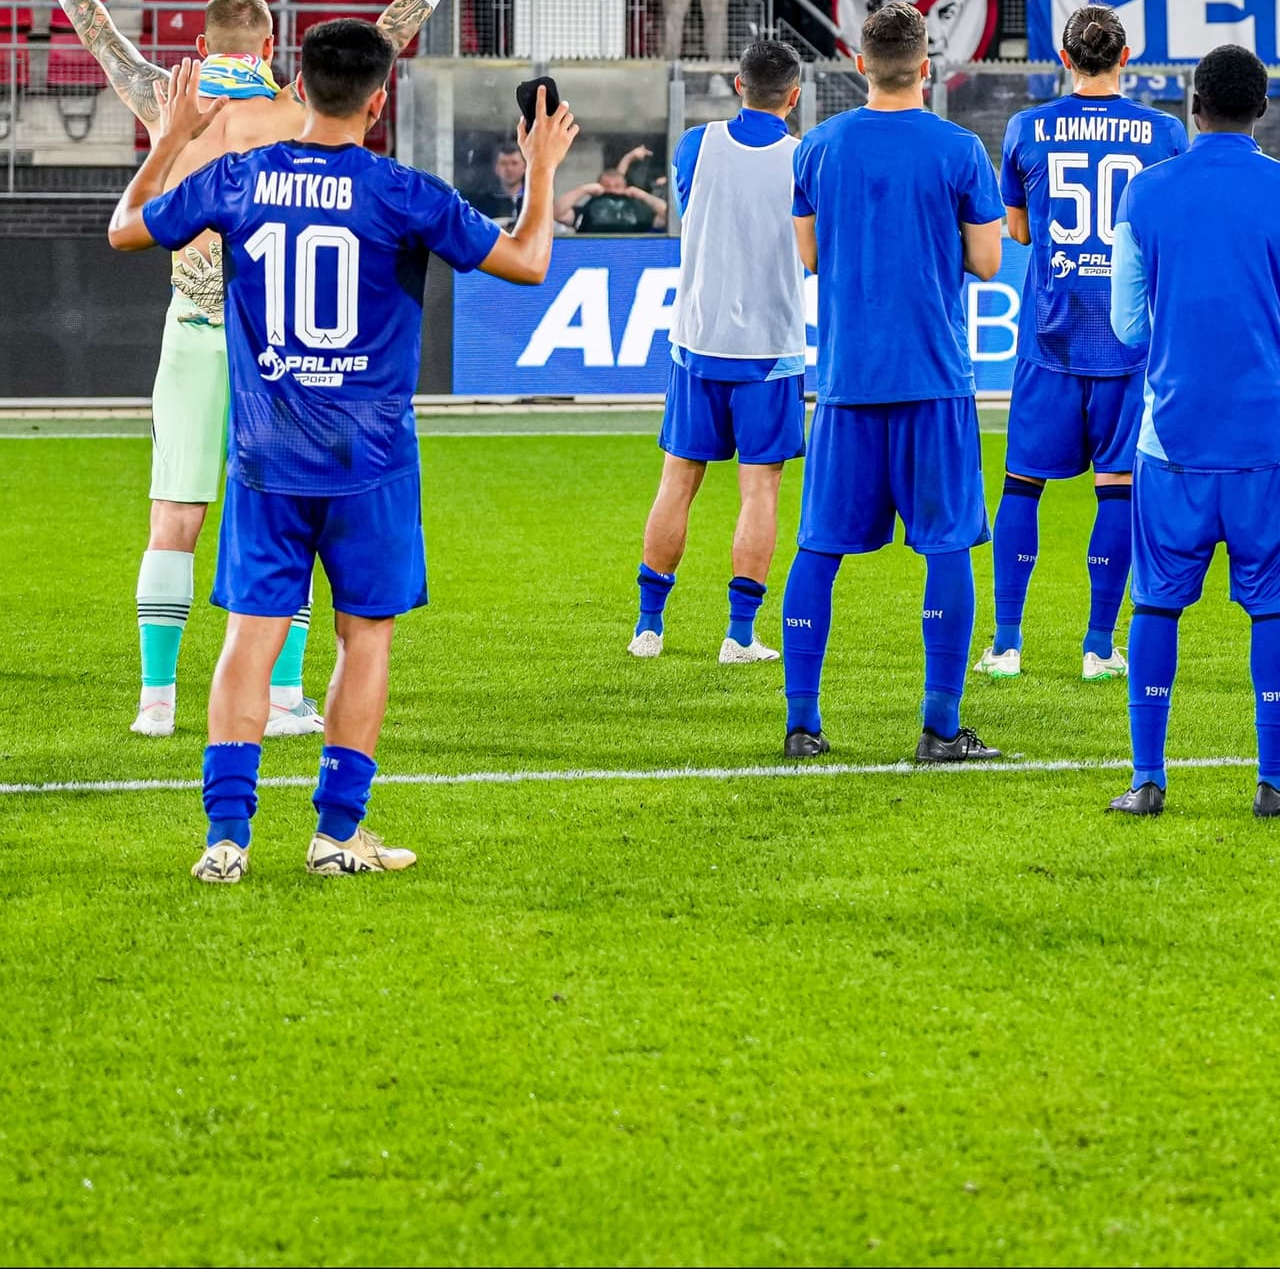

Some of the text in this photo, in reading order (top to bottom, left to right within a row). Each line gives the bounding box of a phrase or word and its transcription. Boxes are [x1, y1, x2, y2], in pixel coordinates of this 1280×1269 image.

[170, 13, 184, 30] 4
[1034, 116, 1153, 144] К. ДИМИТРОВ
[253, 170, 353, 211] МИТКОВ
[1047, 152, 1144, 245] 50
[1078, 253, 1112, 266] PAL
[243, 221, 360, 350] 10
[285, 355, 369, 372] PALMS
[298, 375, 335, 385] PORT
[785, 617, 813, 629] 1914
[1144, 686, 1170, 698] 1914
